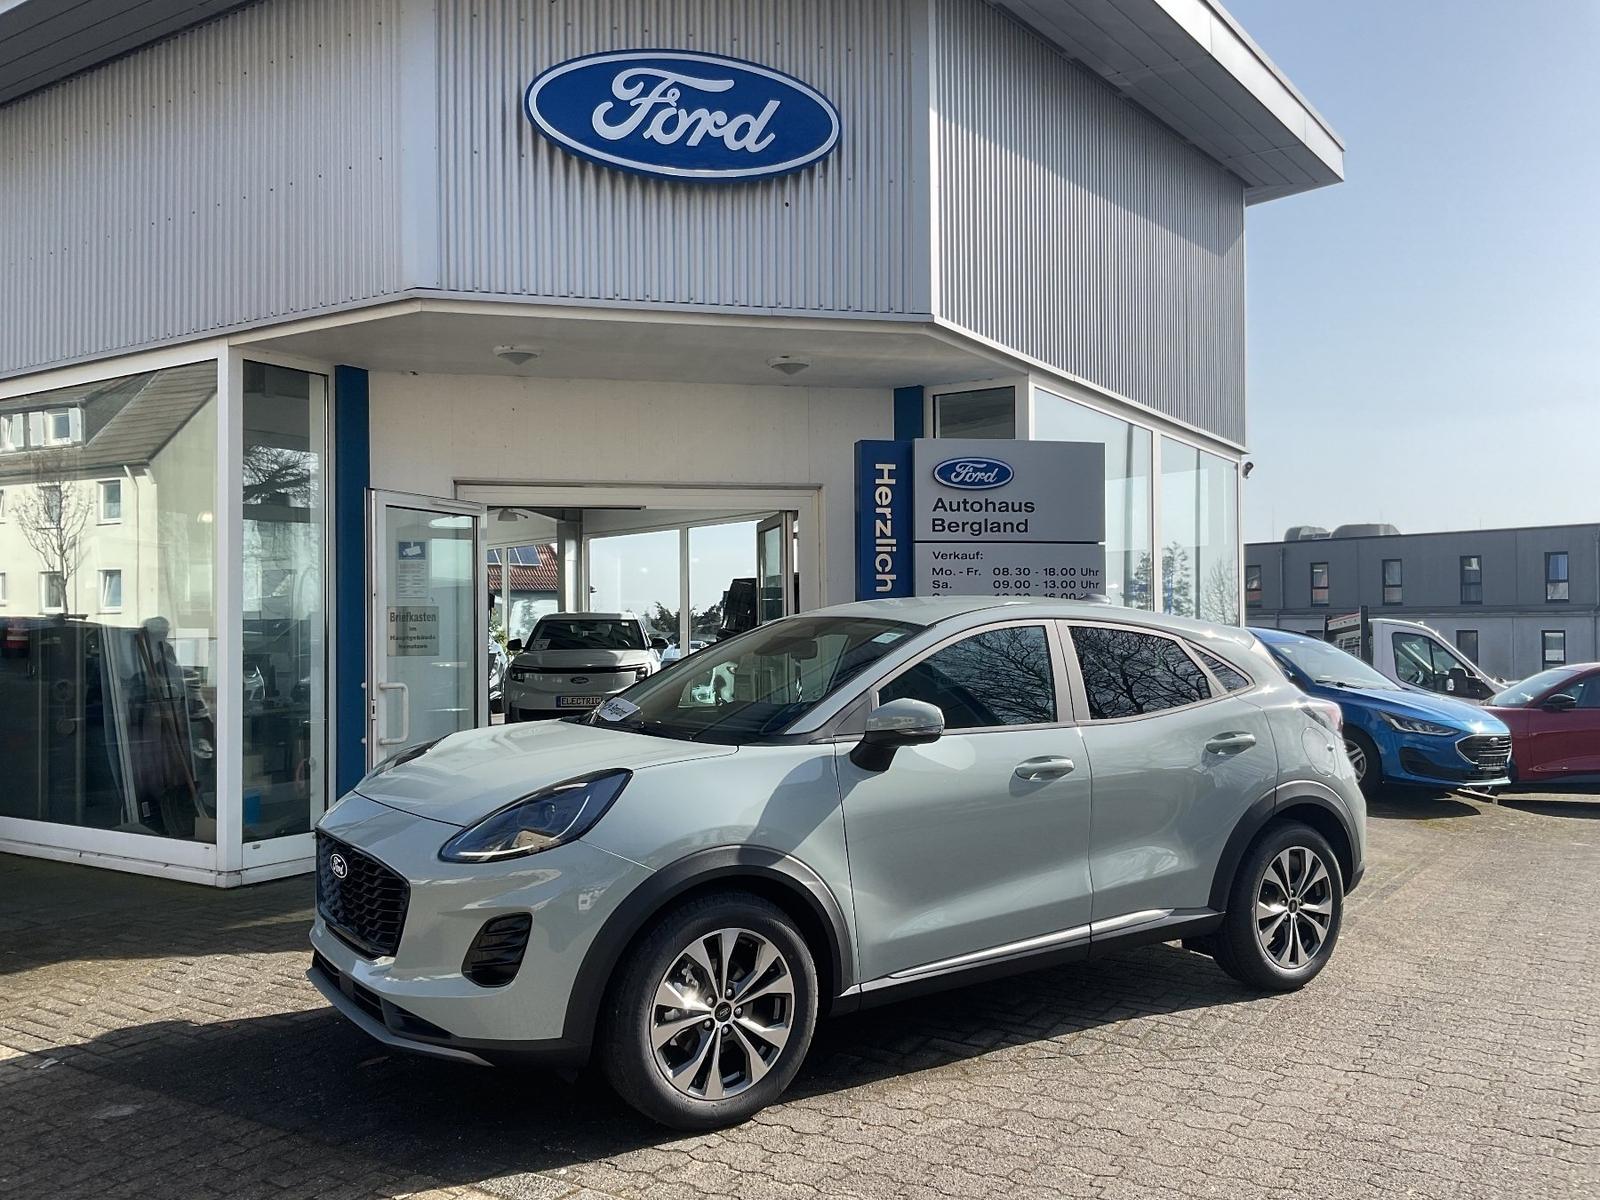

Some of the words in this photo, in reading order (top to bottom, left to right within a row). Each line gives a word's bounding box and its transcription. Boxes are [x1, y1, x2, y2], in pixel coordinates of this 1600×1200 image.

[592, 67, 781, 153] Ford
[950, 462, 999, 483] Ford
[932, 497, 1035, 513] Autohaus
[875, 463, 896, 592] Herzlich
[931, 518, 1029, 536] Bergland
[932, 551, 984, 560] Verkauf:
[992, 567, 1031, 576] 08.30
[1043, 567, 1077, 576] 18.00
[1080, 568, 1100, 577] Uhr
[932, 580, 953, 589] Sa.
[992, 580, 1031, 589] 09.00
[1043, 580, 1077, 589] 13.00
[1080, 580, 1100, 589] Uhr
[389, 611, 437, 622] Briefkasten
